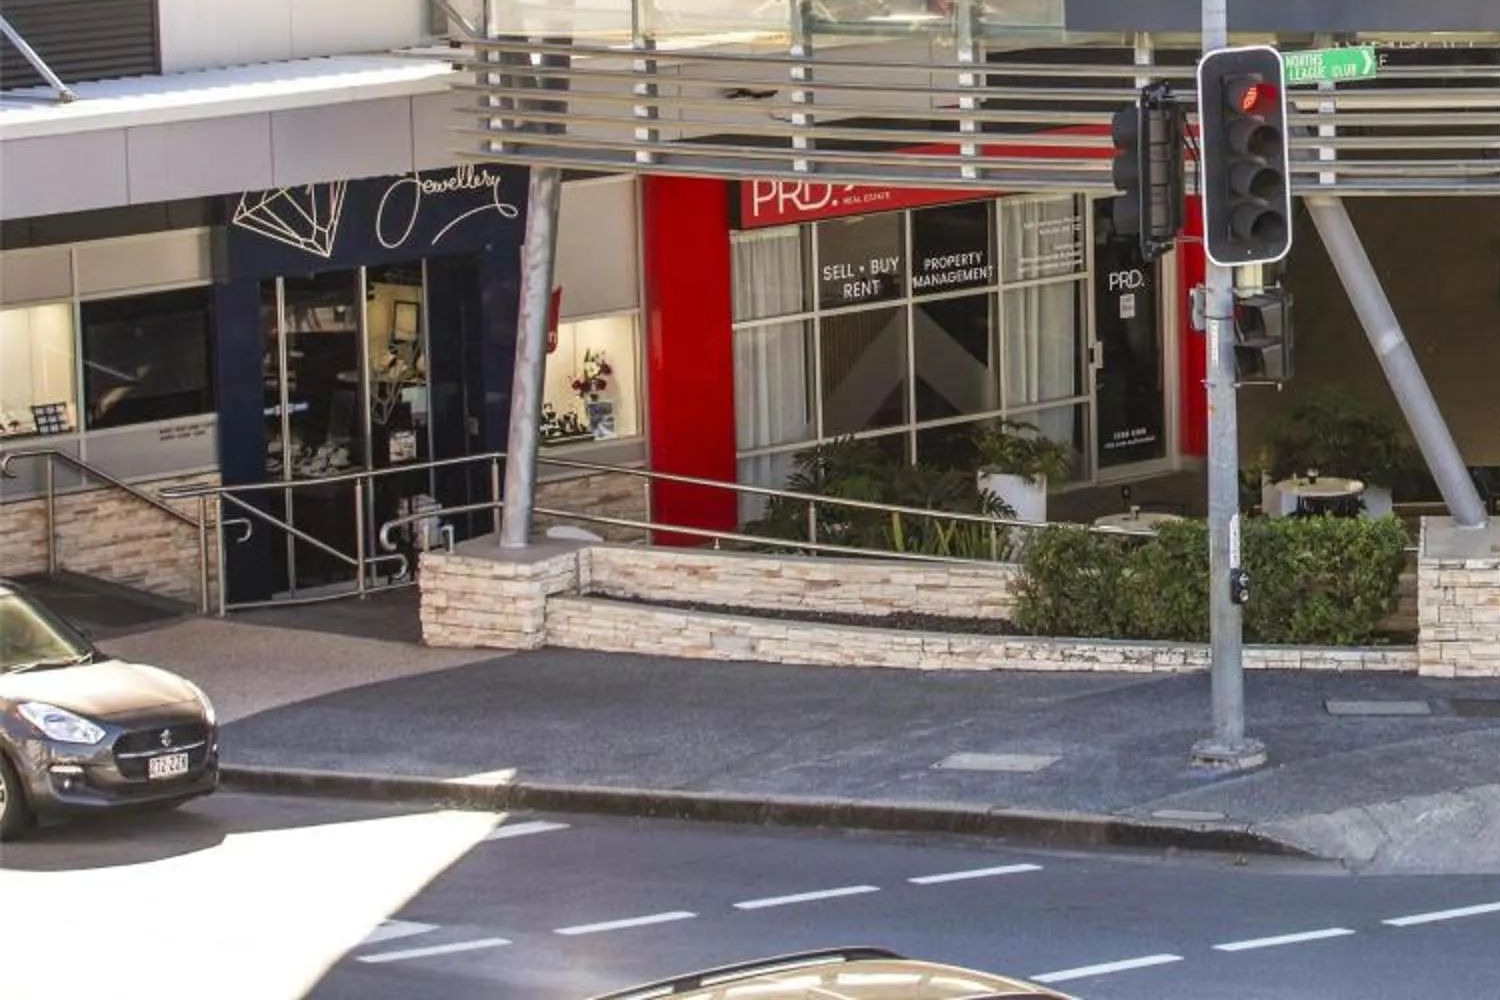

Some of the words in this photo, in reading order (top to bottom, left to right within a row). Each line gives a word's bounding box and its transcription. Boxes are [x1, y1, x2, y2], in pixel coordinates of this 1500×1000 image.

[823, 264, 854, 281] SELL
[871, 256, 899, 275] BUY
[923, 251, 984, 271] PROPERTY
[912, 265, 993, 289] MANAGEMENT
[843, 279, 881, 299] RENT
